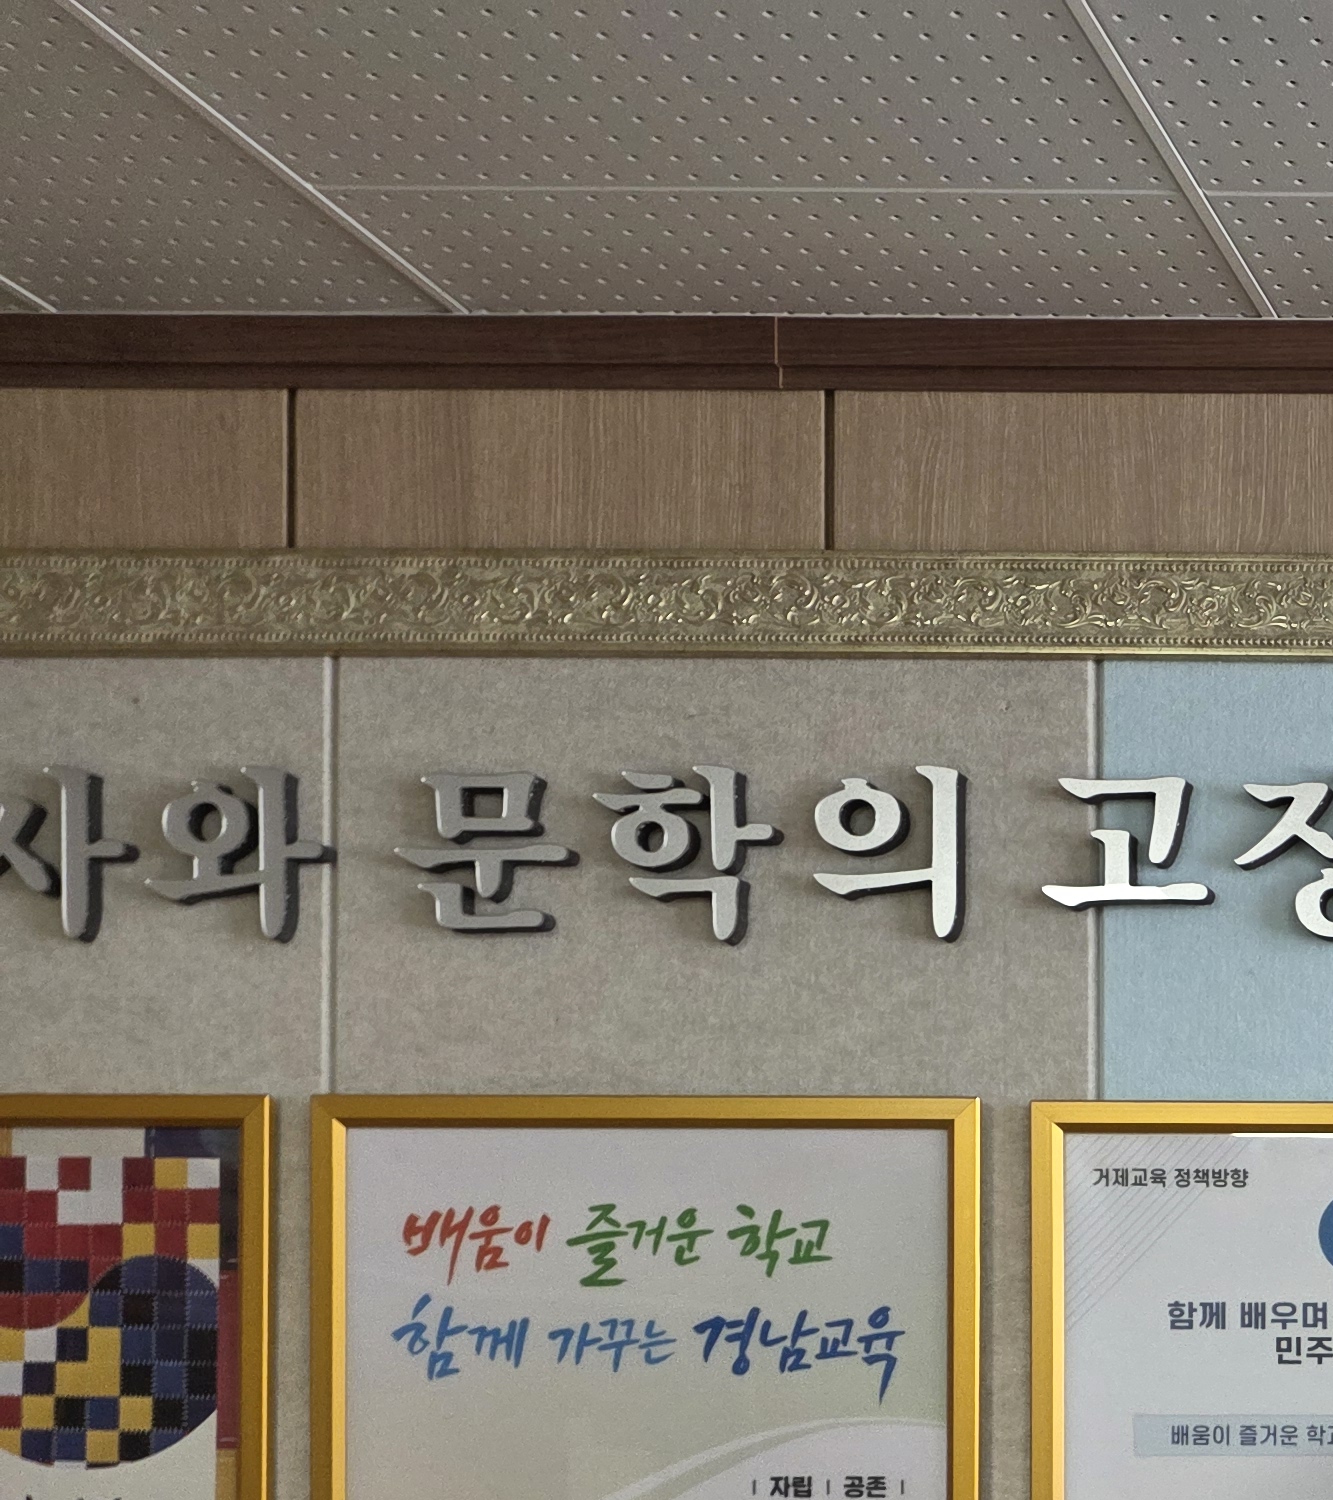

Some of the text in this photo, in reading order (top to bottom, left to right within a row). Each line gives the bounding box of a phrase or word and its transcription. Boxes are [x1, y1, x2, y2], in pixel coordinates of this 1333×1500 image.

[394, 763, 969, 941] 문학의
[1094, 1168, 1248, 1188] 거제교육 정책방향
[404, 1205, 834, 1284] 배움이 즐거운 학교
[1168, 1301, 1226, 1330] 함께
[1241, 1302, 1327, 1330] 배우며
[390, 1294, 906, 1403] 함께 가꾸는 경남교육
[1171, 1425, 1230, 1446] 배움이
[1239, 1425, 1298, 1446] 즐거운
[770, 1476, 886, 1498] 자립 공존
